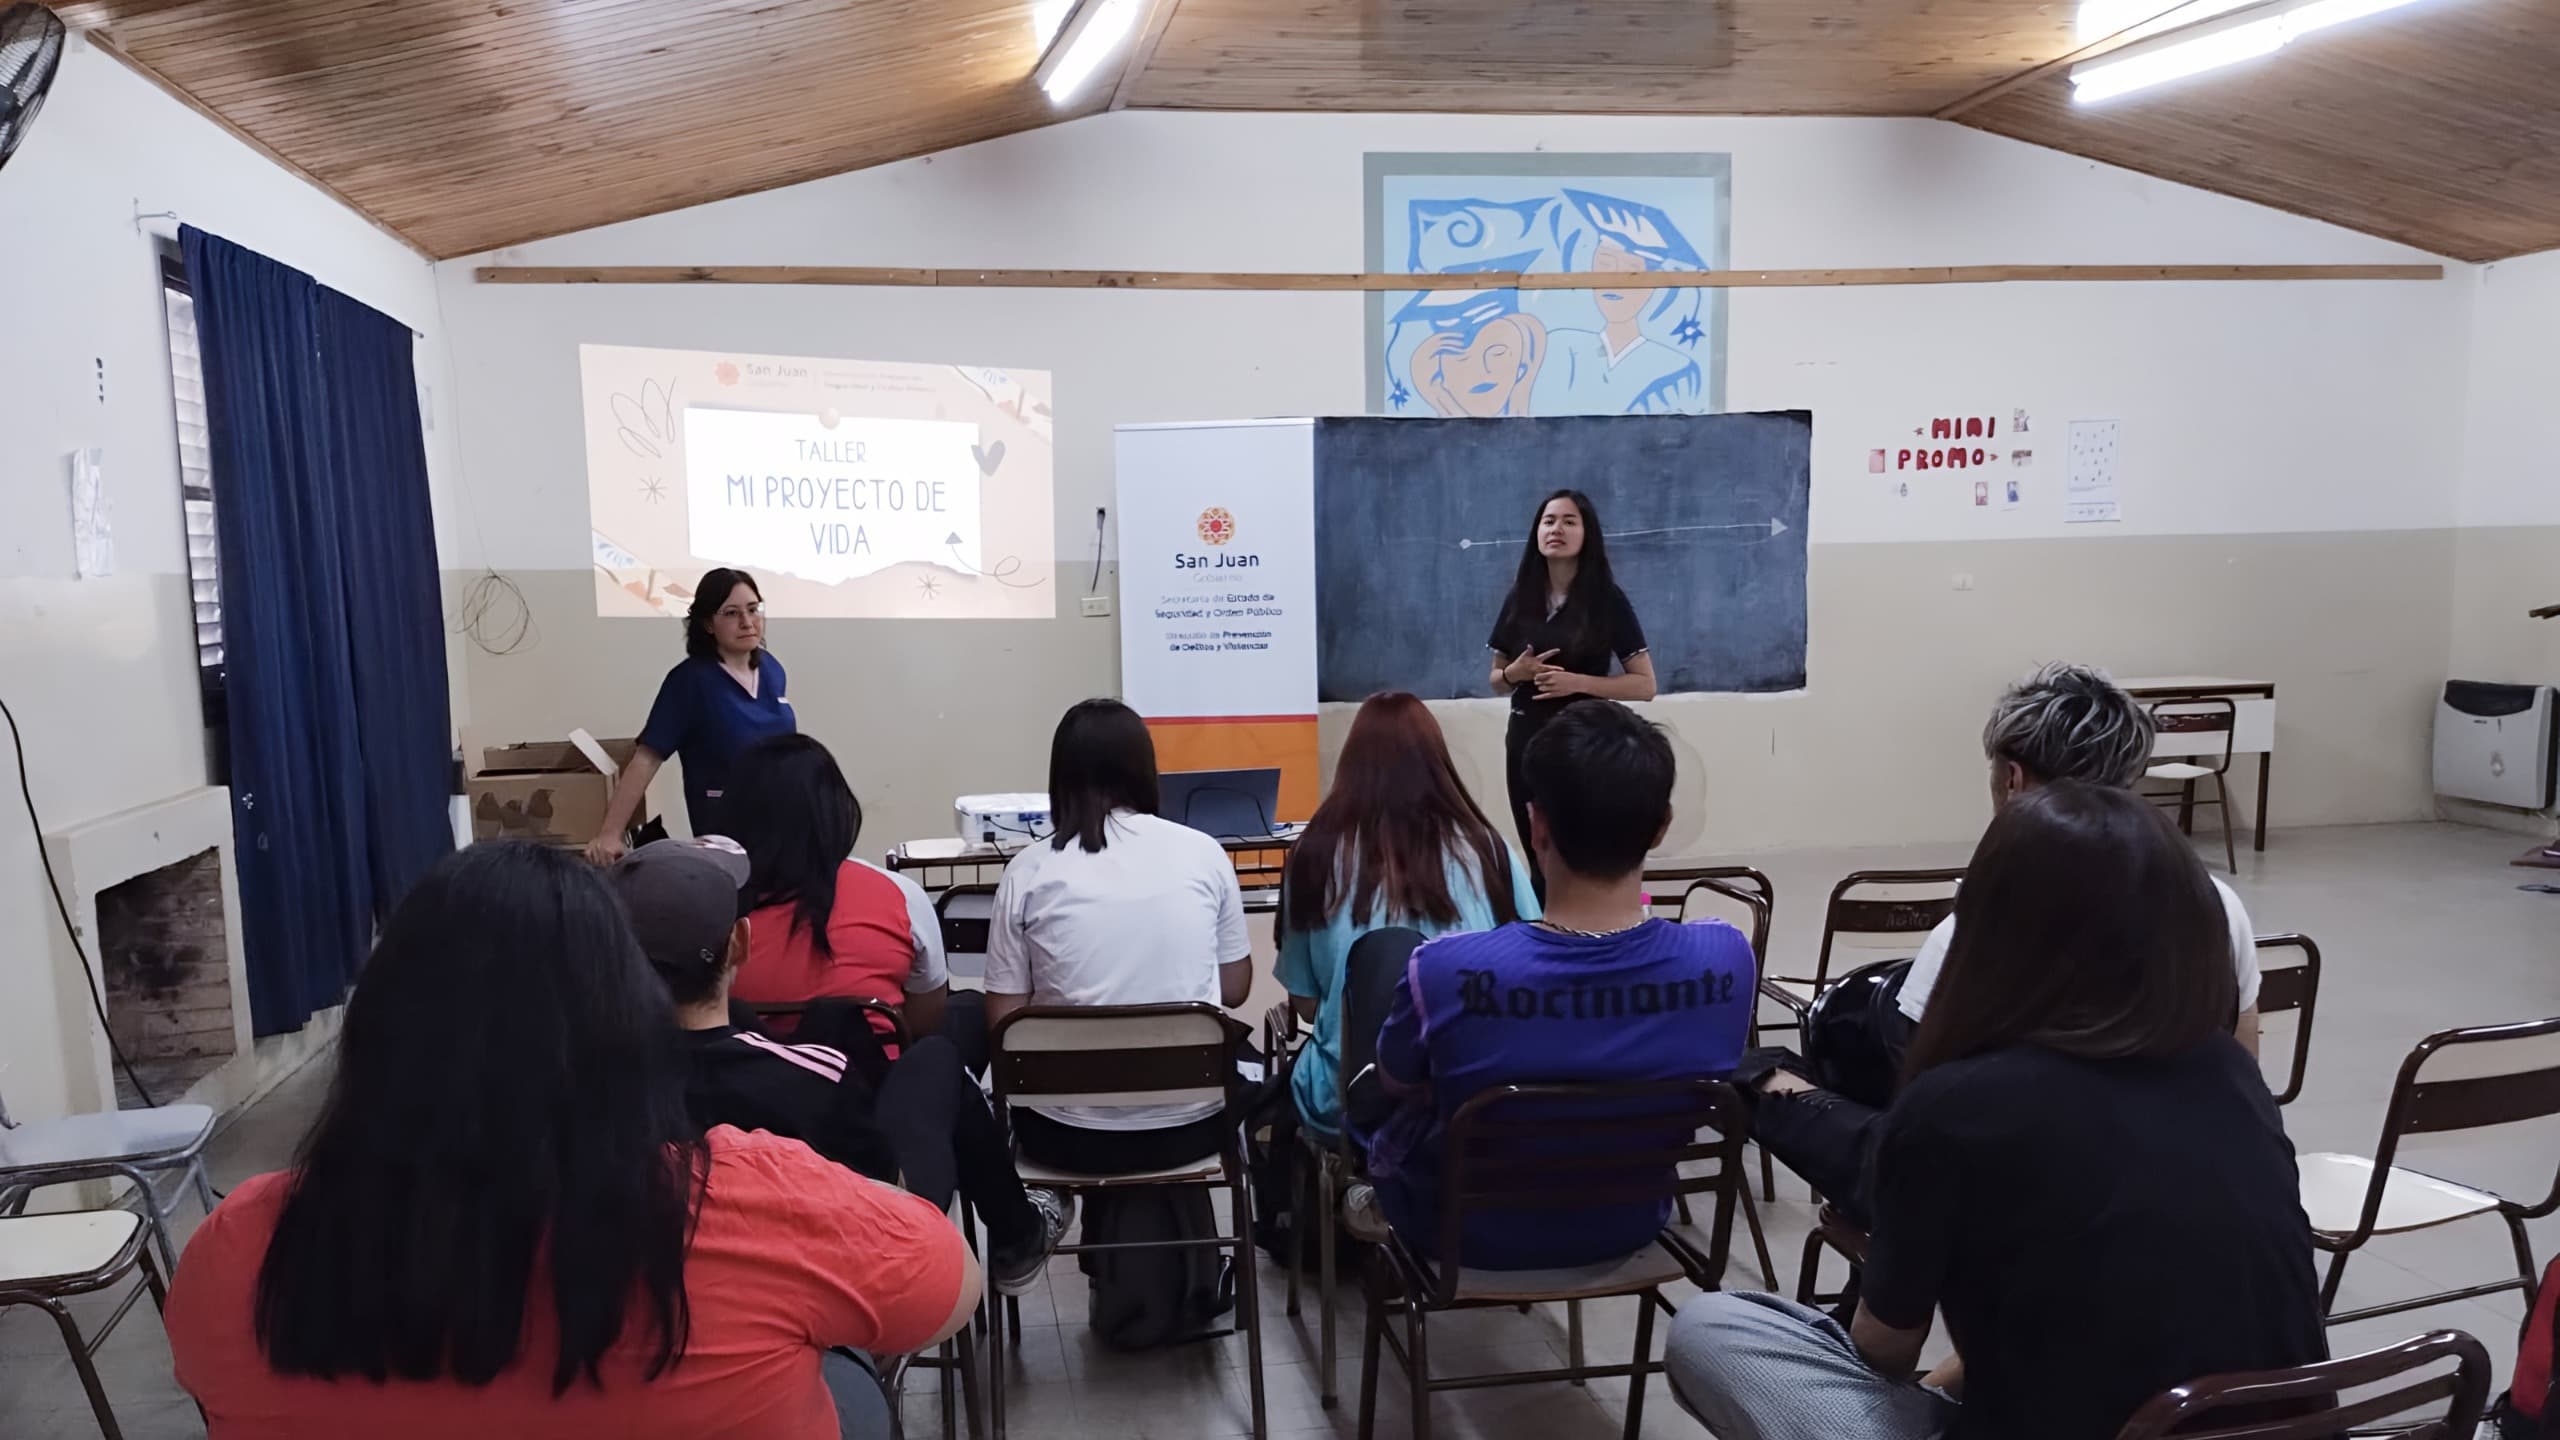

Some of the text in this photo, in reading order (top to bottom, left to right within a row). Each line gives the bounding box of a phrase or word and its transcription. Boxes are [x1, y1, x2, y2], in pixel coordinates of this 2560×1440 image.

[1931, 416, 1996, 440] MINI
[795, 438, 867, 464] TALLER
[1897, 446, 1985, 471] PROMO
[726, 474, 947, 513] MI PROYECTO DE
[809, 522, 872, 556] VIDA
[1175, 552, 1260, 569] San Juan
[1456, 968, 1735, 1021] Rocinante
